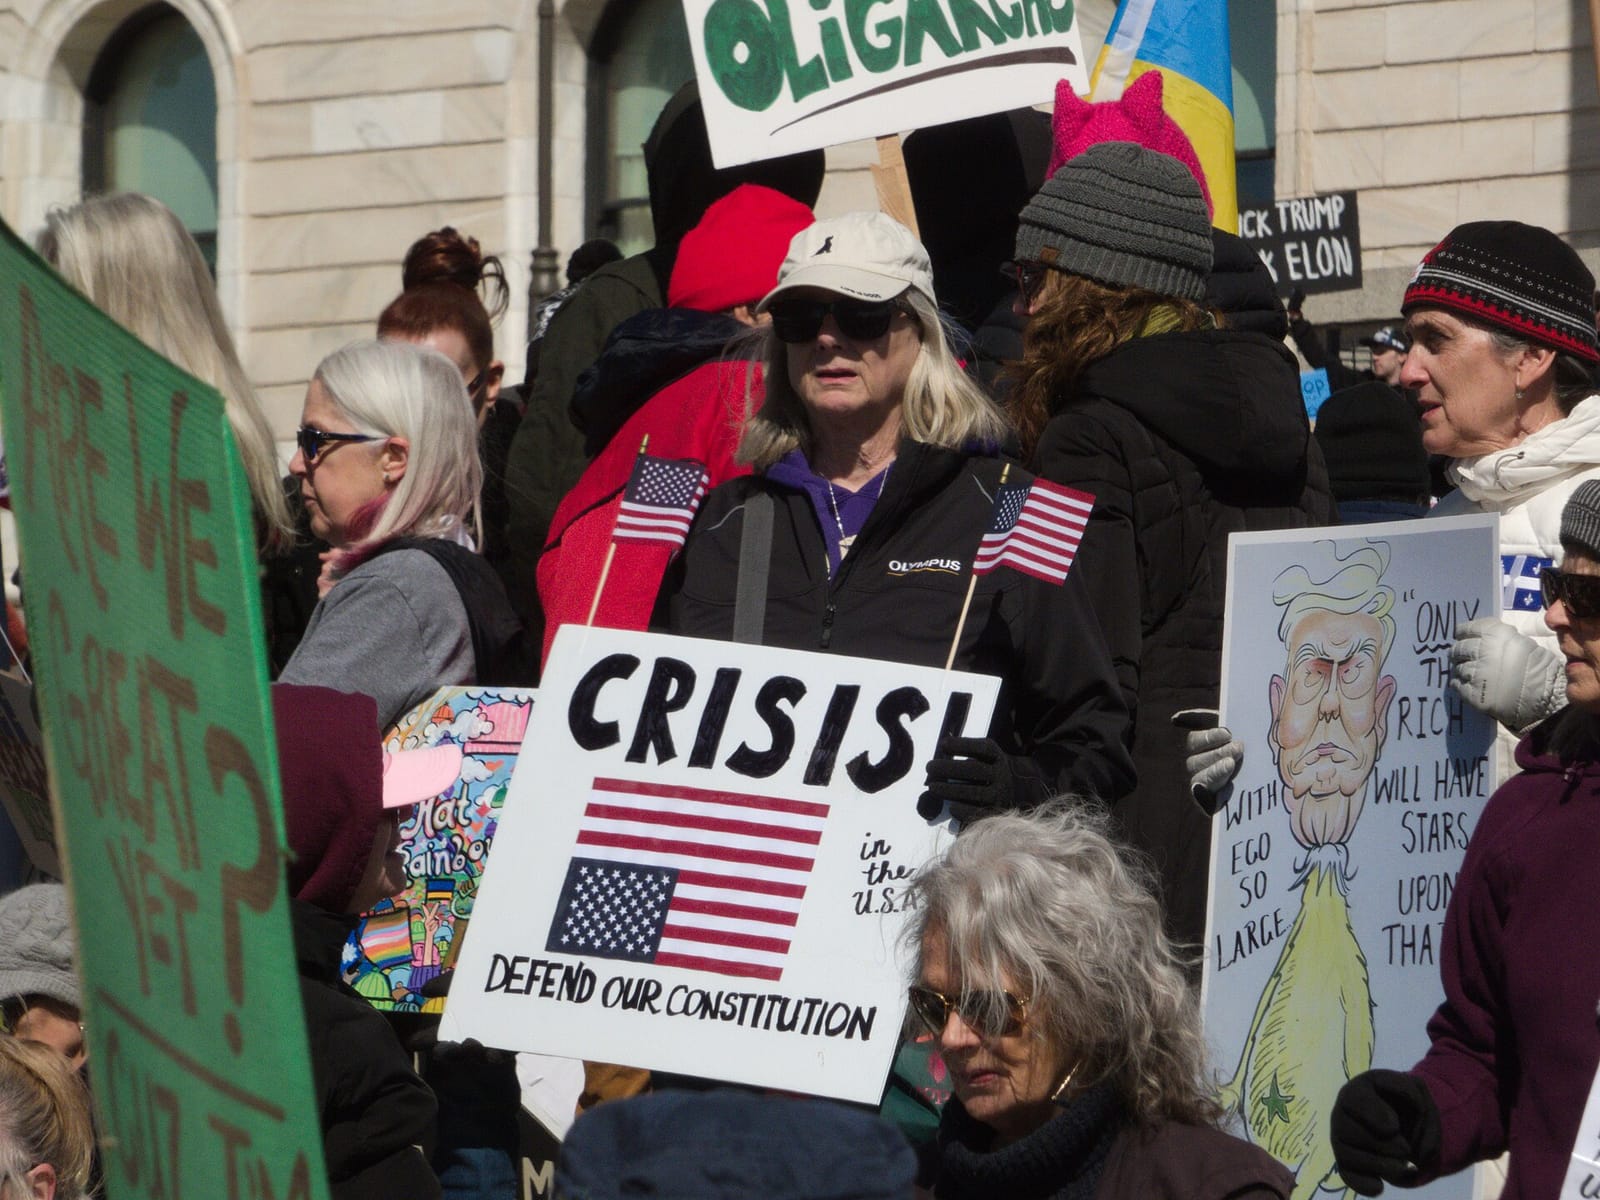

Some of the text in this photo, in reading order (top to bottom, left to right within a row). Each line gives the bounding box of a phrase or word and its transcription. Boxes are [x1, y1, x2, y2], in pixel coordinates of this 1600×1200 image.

[1274, 194, 1346, 234] TRUMP
[1284, 235, 1353, 281] ELON
[20, 282, 227, 641] ARE WE
[888, 558, 961, 572] OLYMPUS
[1420, 657, 1452, 689] TH
[47, 586, 200, 872] GREAT
[1397, 696, 1463, 740] RICH
[1374, 756, 1489, 804] WILL HAVE
[1225, 779, 1277, 831] WITH
[860, 832, 892, 861] in
[1232, 832, 1271, 875] EGO
[1401, 810, 1470, 854] STARS
[861, 860, 918, 886] the
[1240, 870, 1267, 909] SO
[1381, 921, 1446, 967] THA
[484, 953, 878, 1042] DEFEND OUR CONSTITUTION
